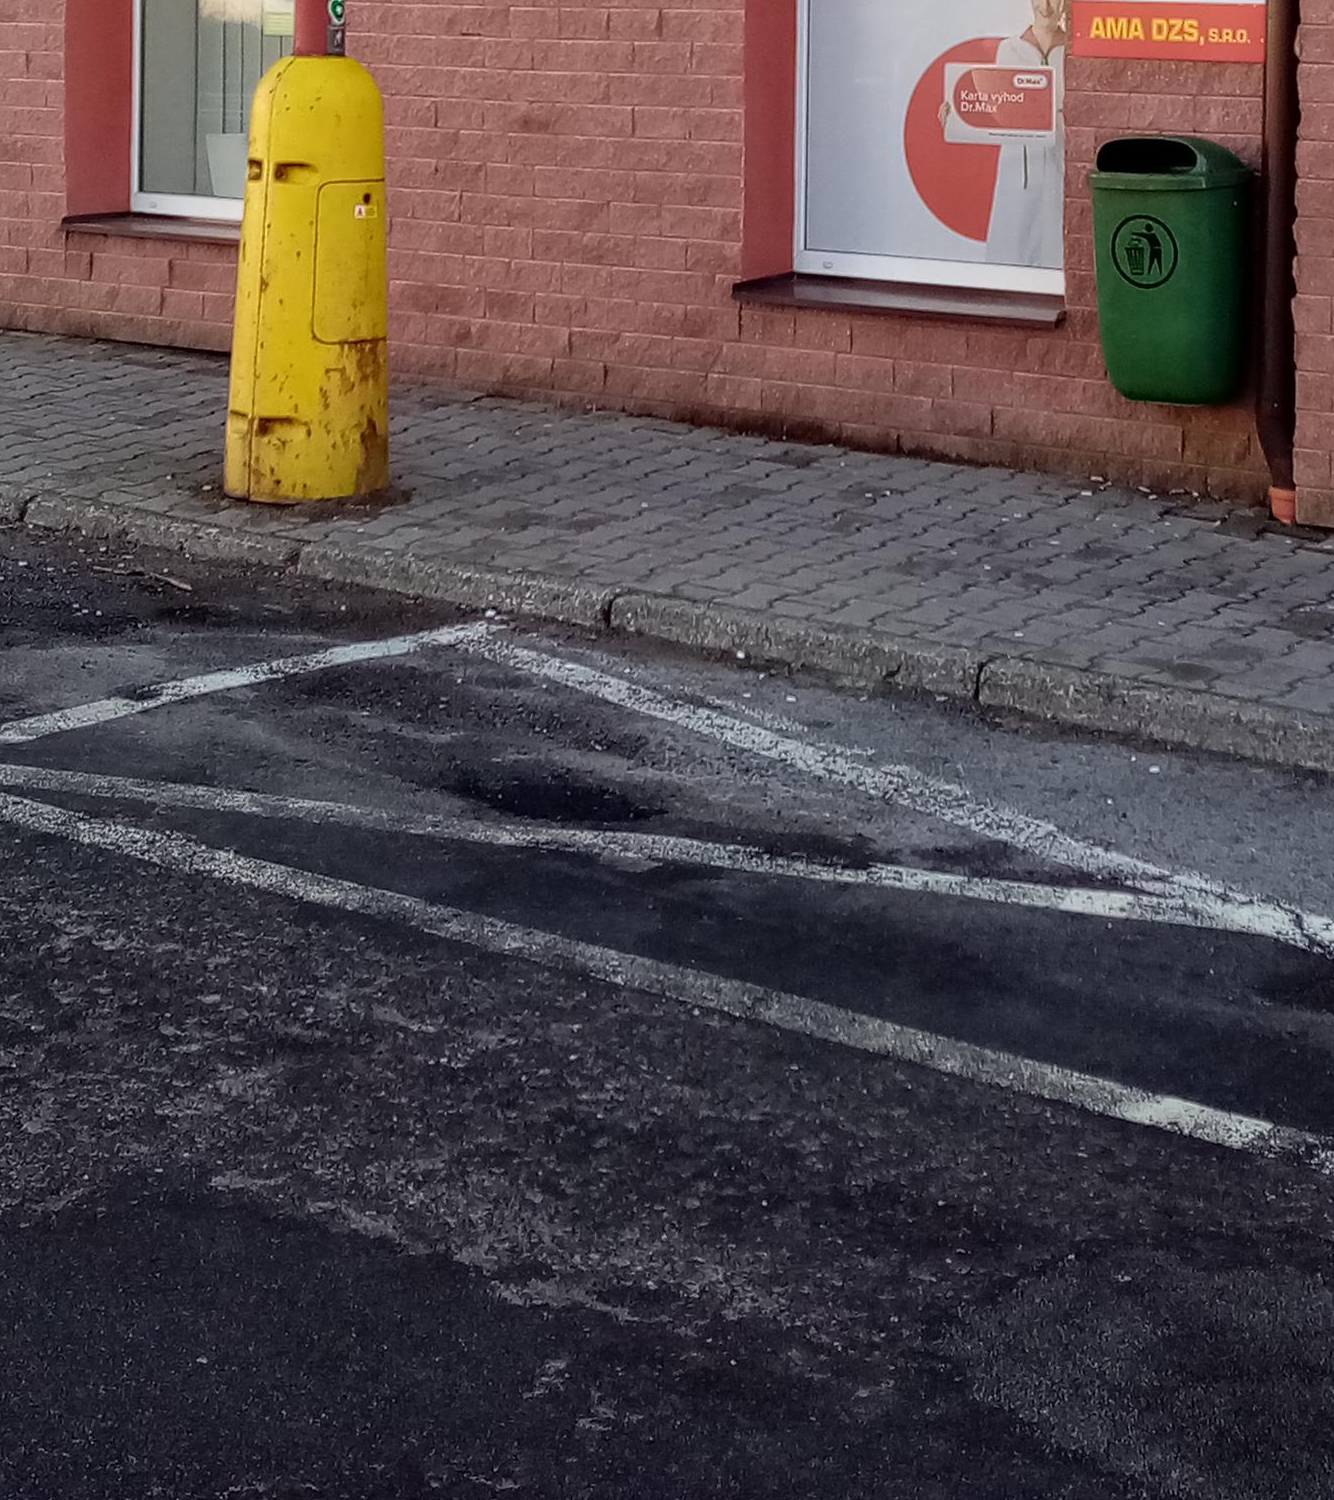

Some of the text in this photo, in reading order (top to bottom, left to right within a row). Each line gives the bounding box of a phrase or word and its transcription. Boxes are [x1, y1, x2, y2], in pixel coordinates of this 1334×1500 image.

[1089, 16, 1252, 46] AMA DZS, S.R.O.
[960, 90, 989, 102] Karta
[960, 102, 998, 114] Dr.Max
